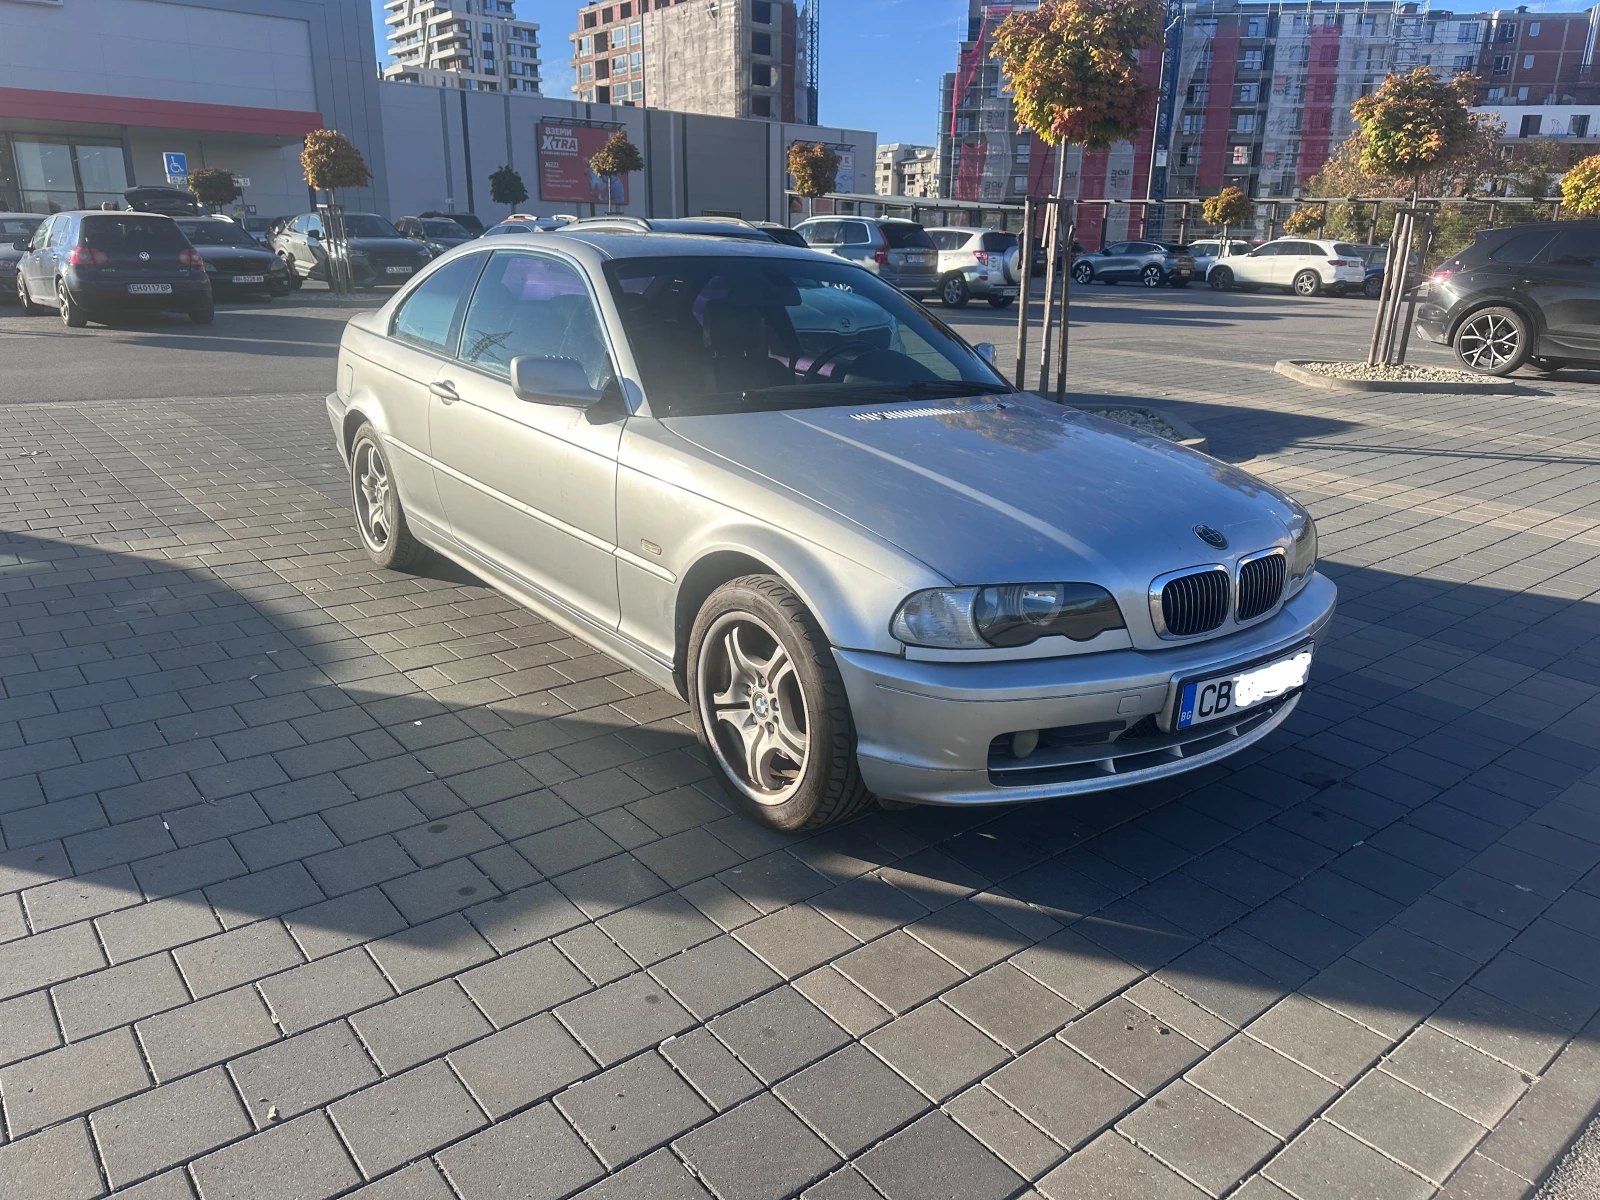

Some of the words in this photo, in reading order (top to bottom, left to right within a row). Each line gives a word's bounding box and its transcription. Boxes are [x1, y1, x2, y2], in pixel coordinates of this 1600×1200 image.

[545, 127, 572, 136] ВЗЕМИ
[541, 136, 578, 152] XTRA
[142, 284, 160, 292] 0117
[1199, 681, 1232, 717] CB
[1181, 710, 1192, 722] BG
